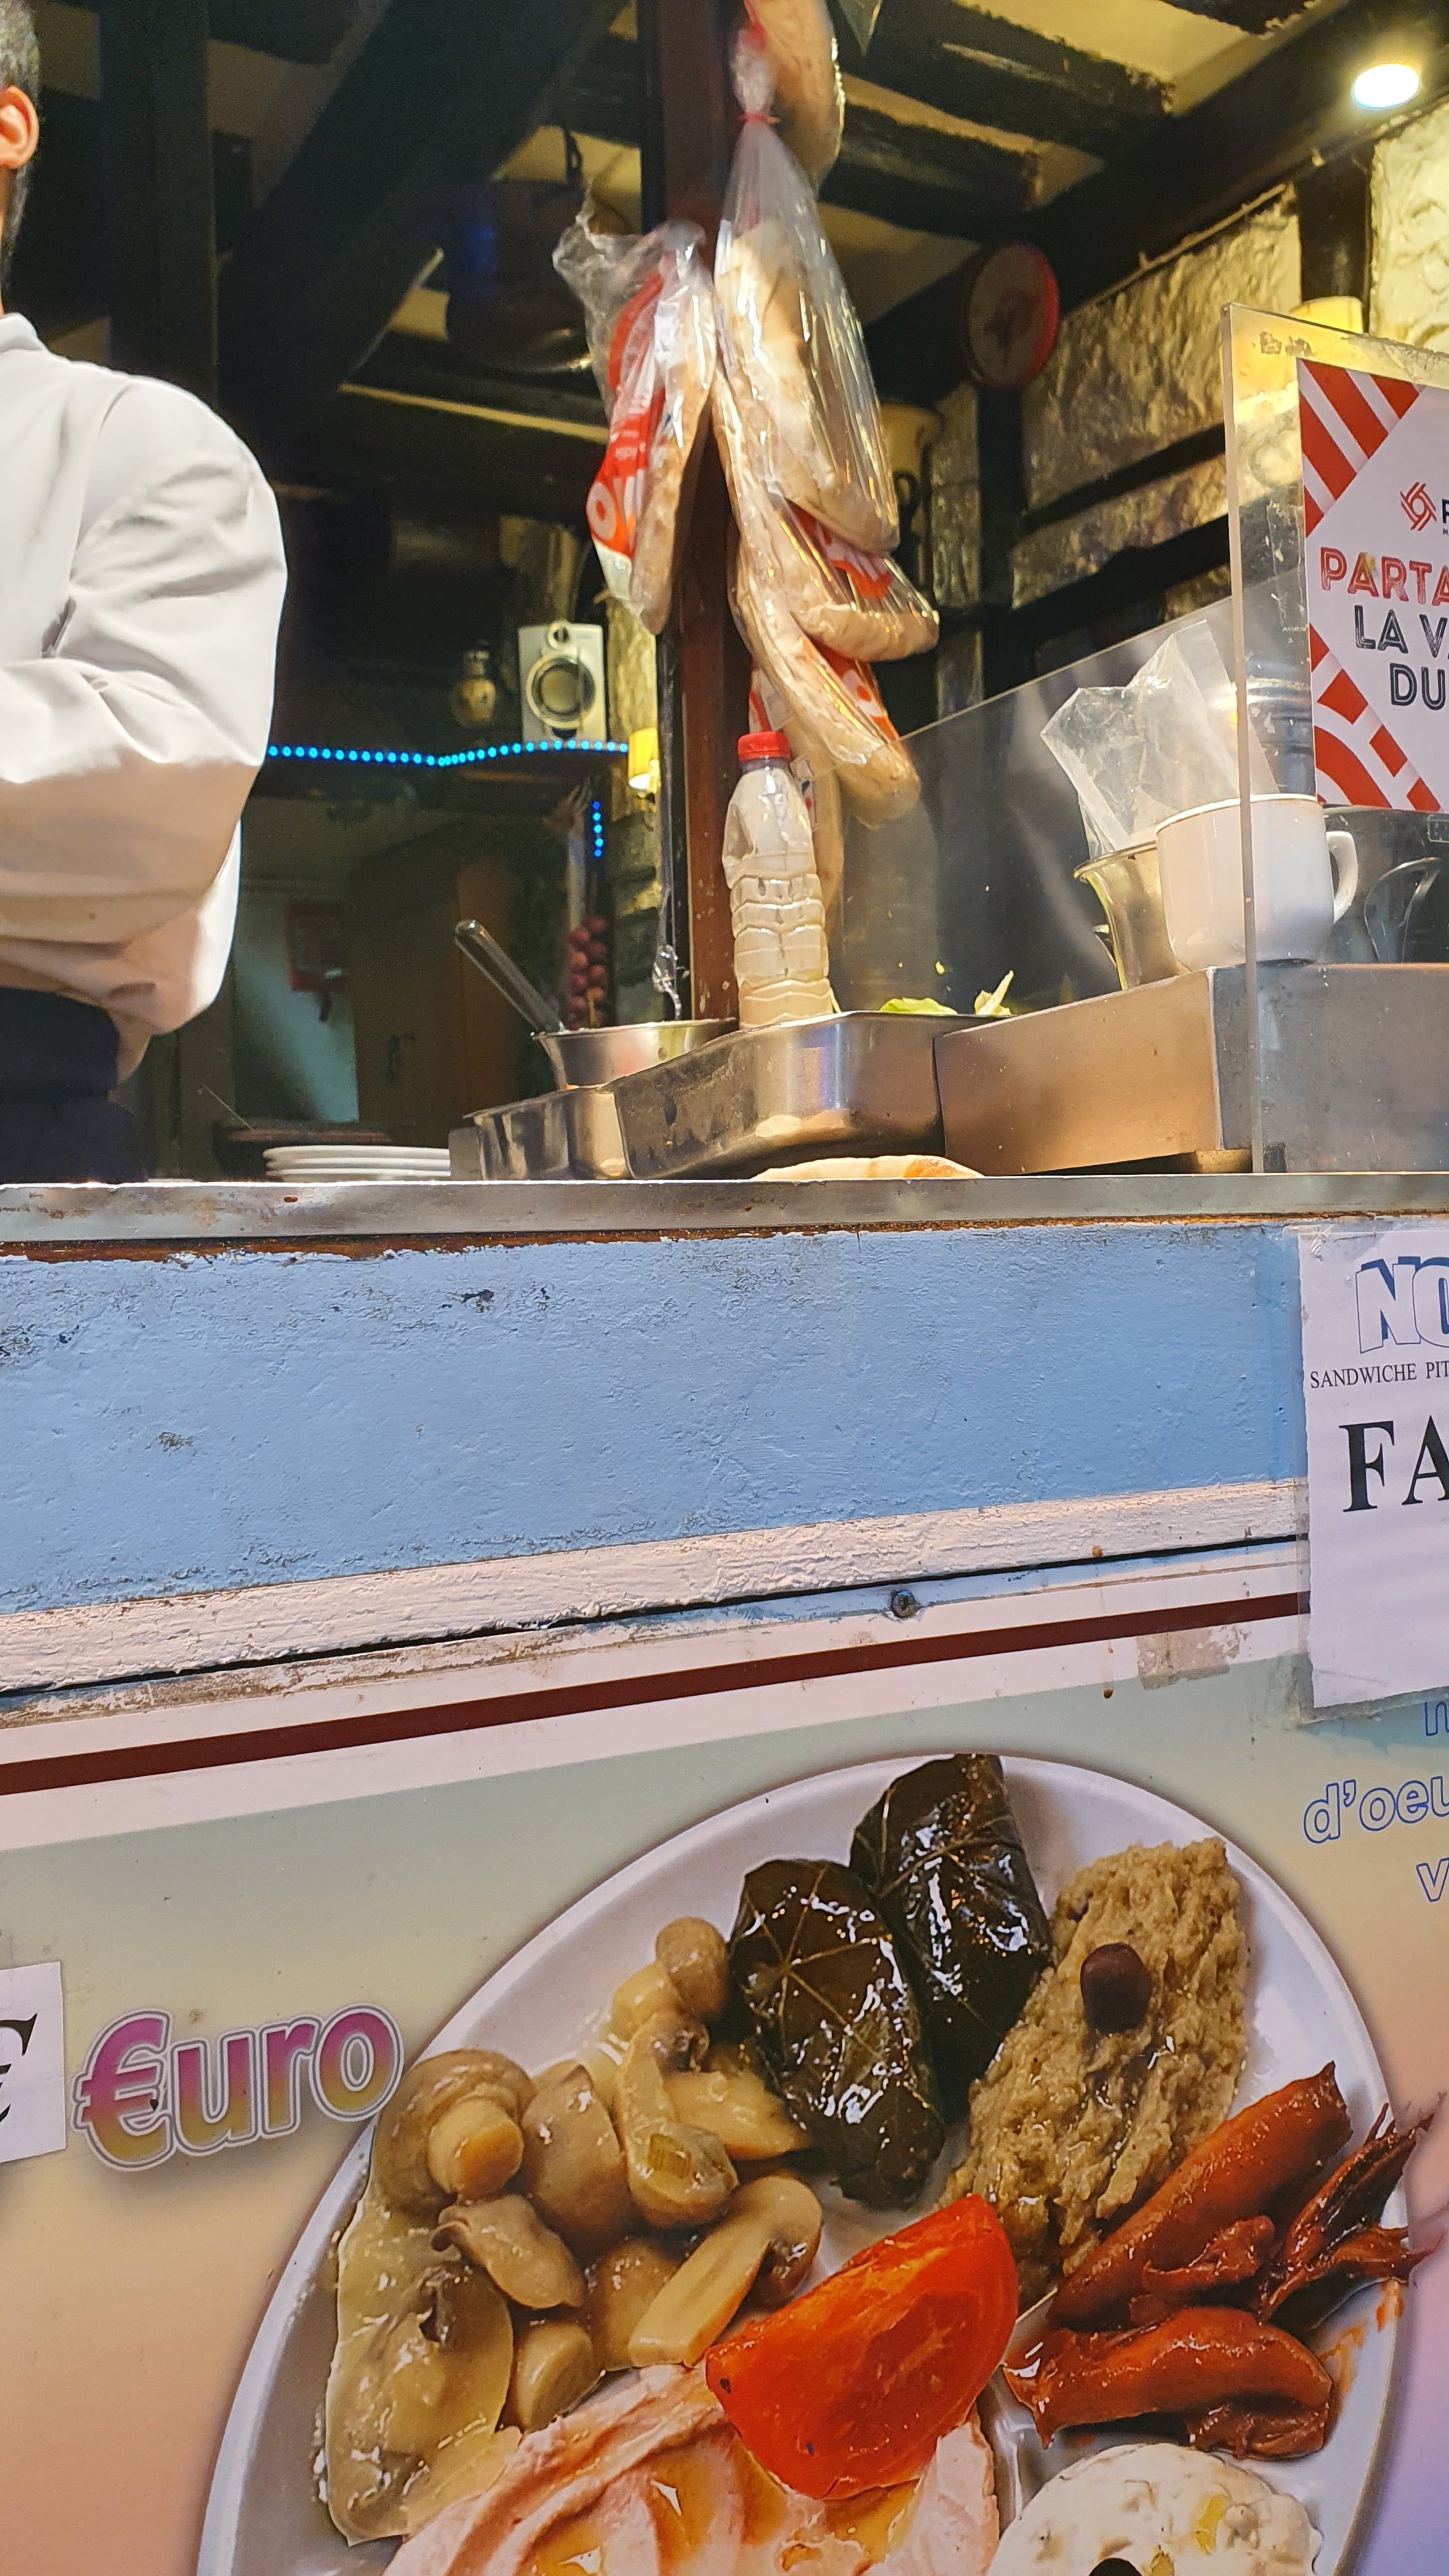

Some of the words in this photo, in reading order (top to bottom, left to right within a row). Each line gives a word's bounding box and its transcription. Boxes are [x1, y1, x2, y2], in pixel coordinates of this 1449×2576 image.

[1354, 604, 1409, 654] LA
[1419, 614, 1449, 659] V
[1390, 662, 1446, 710] DU
[1310, 1363, 1416, 1389] SANDWICHE
